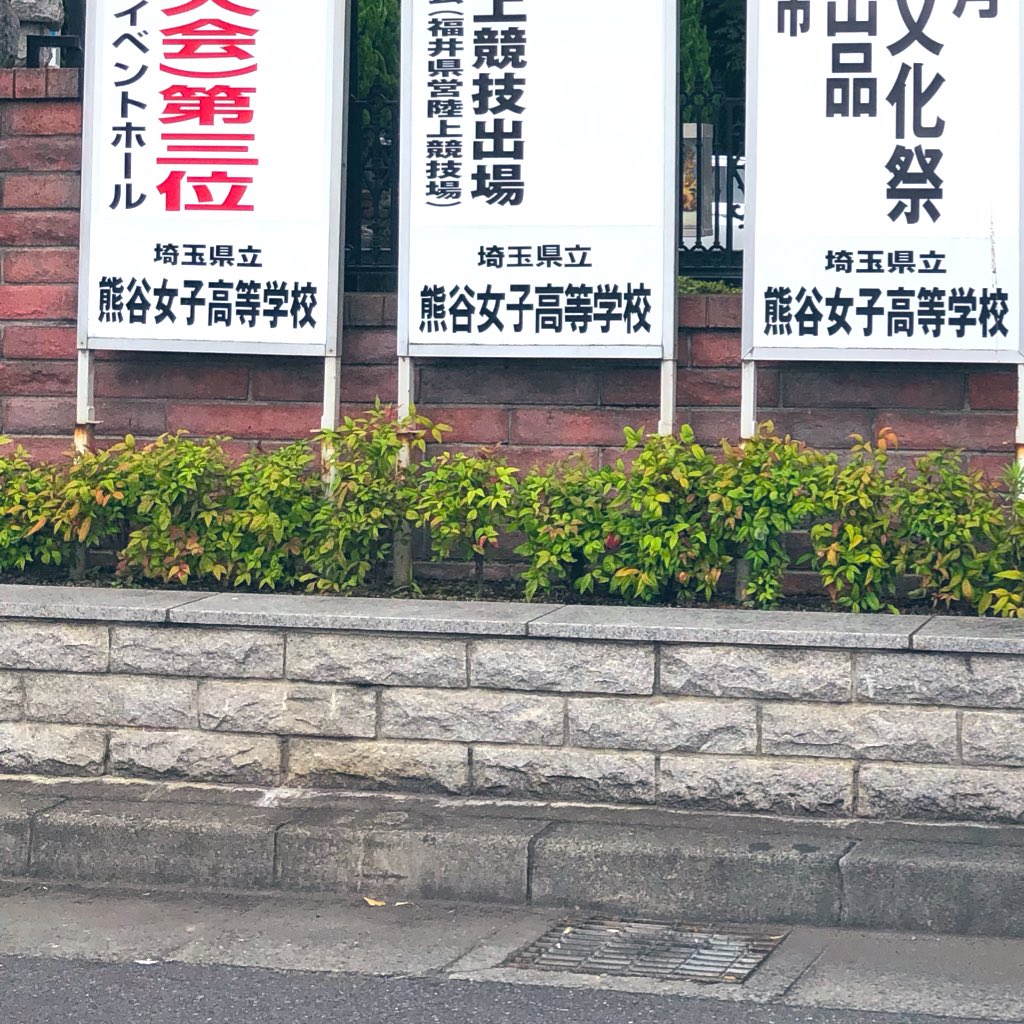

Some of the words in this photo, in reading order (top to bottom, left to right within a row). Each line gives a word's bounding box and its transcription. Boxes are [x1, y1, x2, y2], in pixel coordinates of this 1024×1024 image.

[109, 0, 149, 209] イベントホール
[154, 243, 262, 267] 埼玉県立
[478, 245, 592, 268] 埼玉県立
[825, 250, 946, 274] 埼玉県立
[98, 276, 317, 328] 熊谷女子高等学校
[419, 283, 651, 334] 熊谷女子高等学校
[764, 287, 1008, 338] 熊谷女子高等学校
